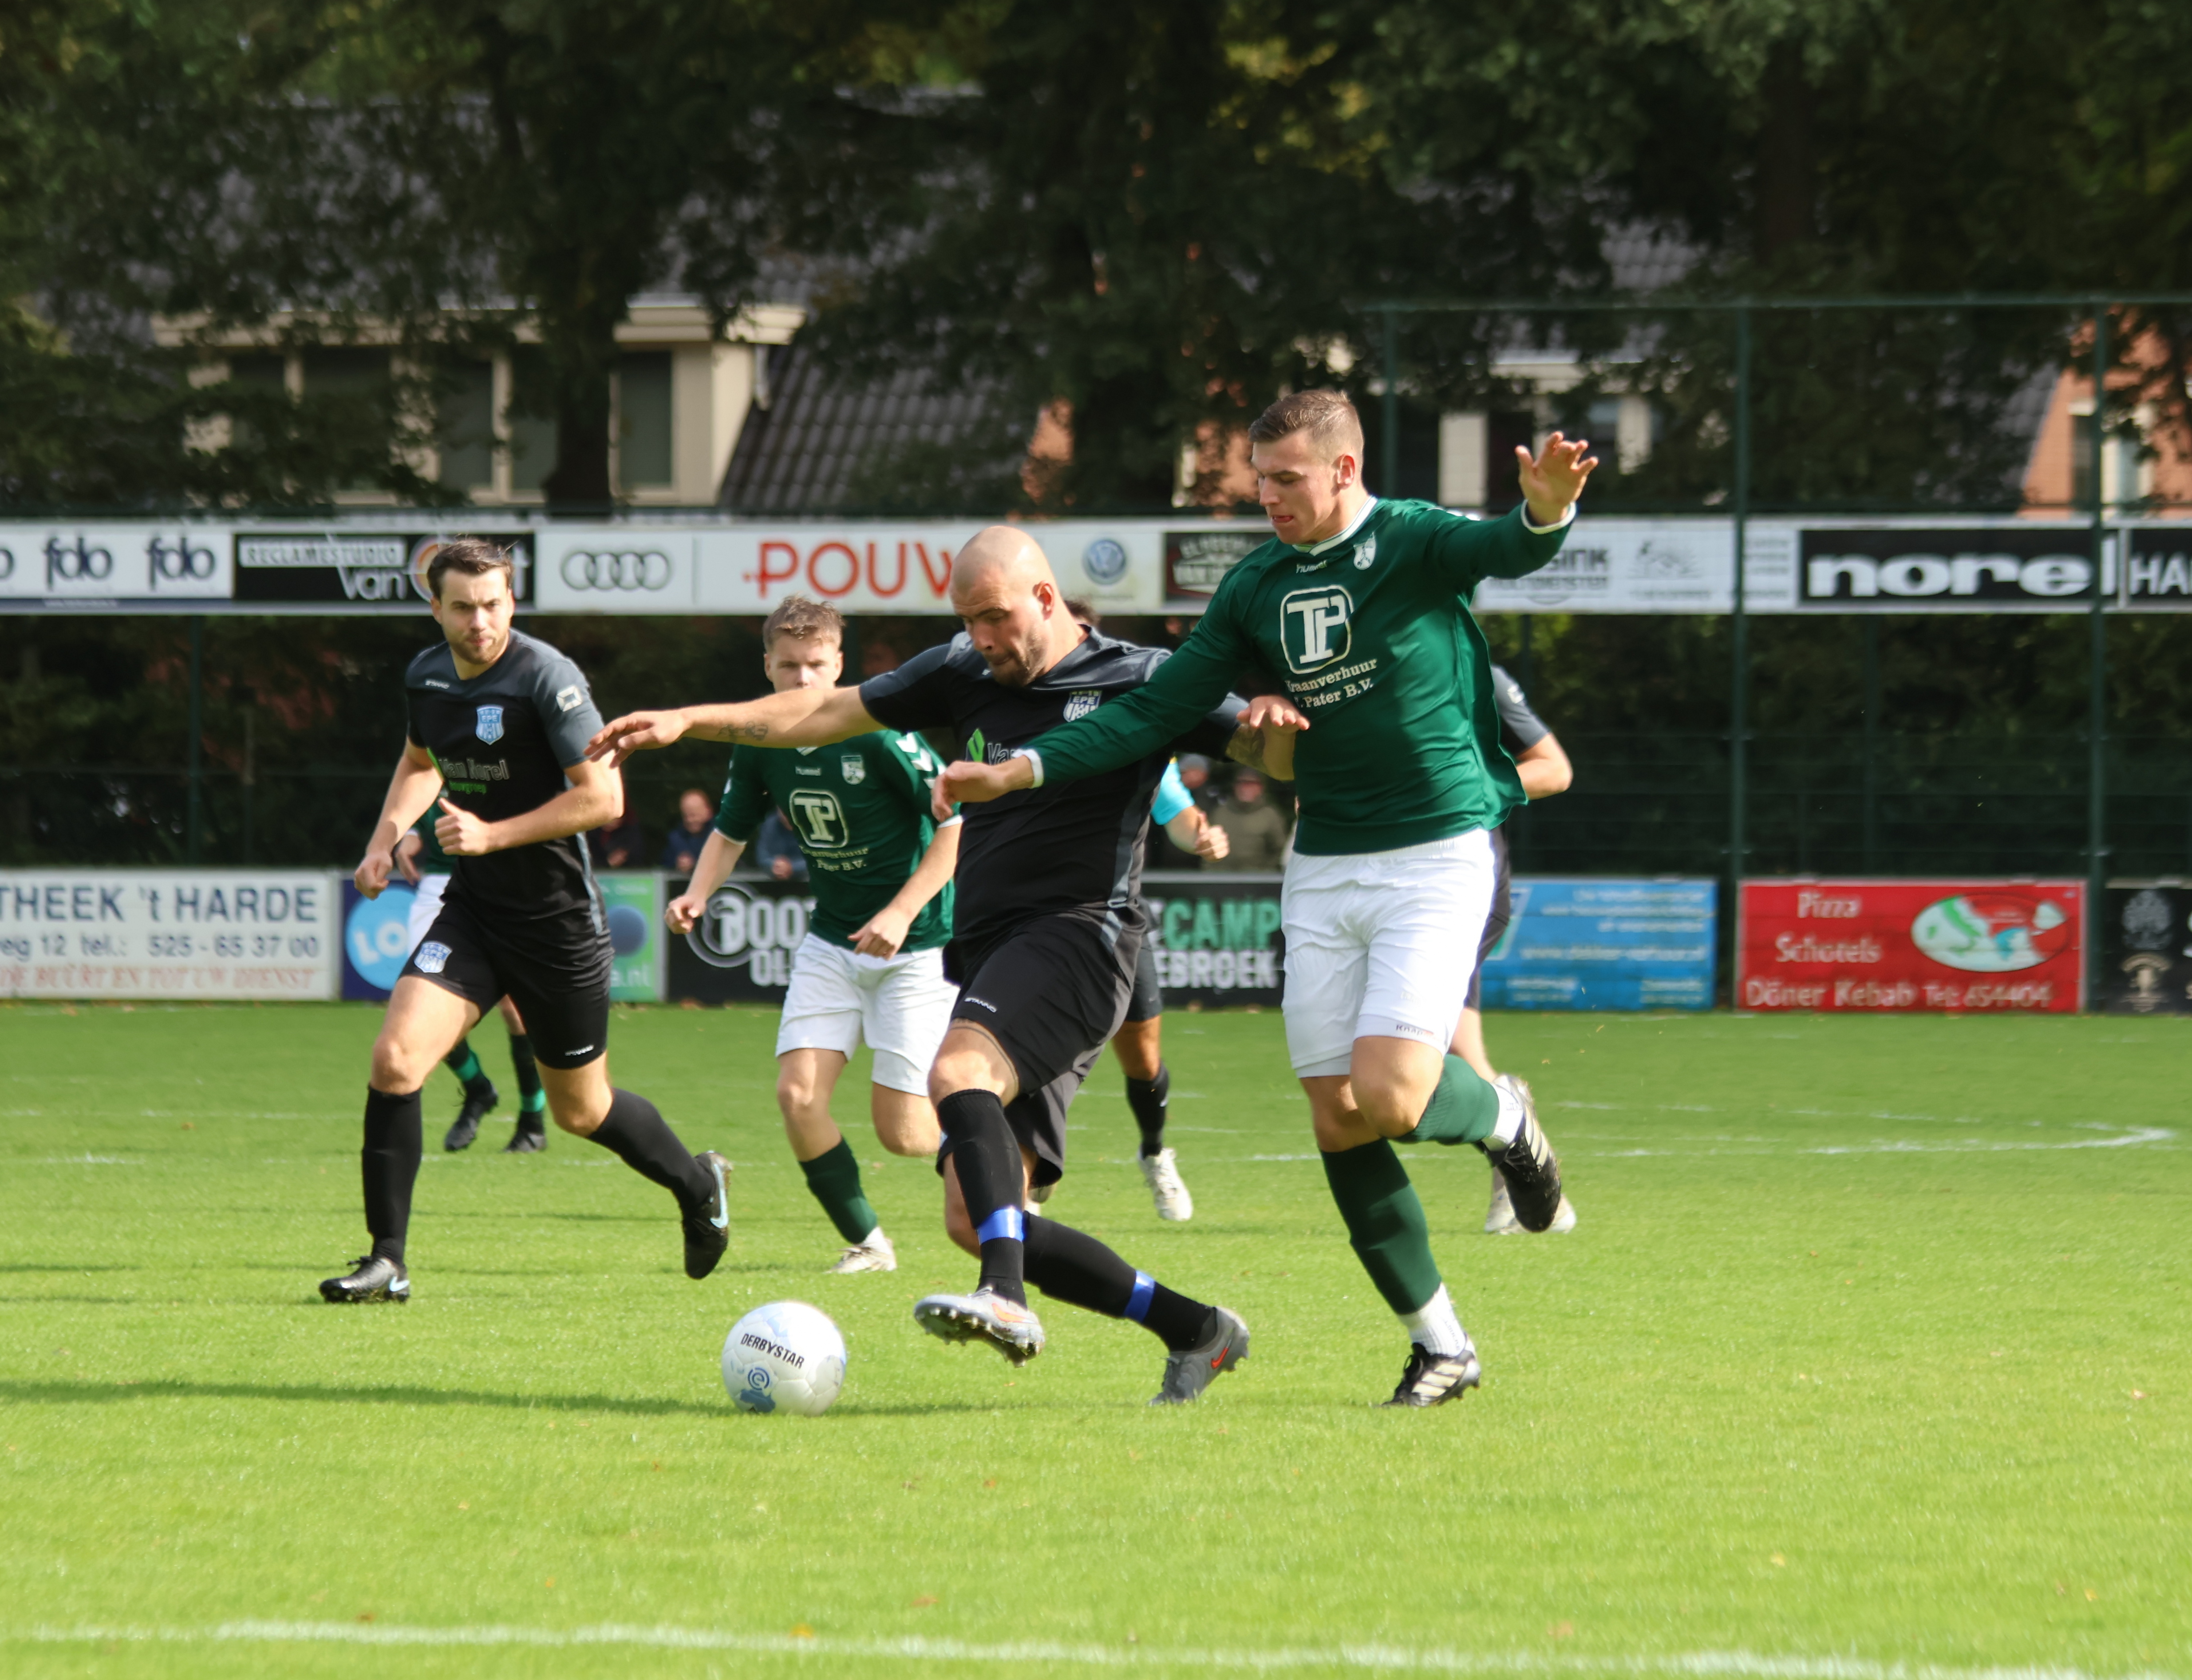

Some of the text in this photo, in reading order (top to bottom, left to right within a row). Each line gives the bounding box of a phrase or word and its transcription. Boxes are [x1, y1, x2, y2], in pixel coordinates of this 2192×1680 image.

[246, 546, 397, 562] RECLAMESTUDIO
[2129, 554, 2192, 595] HA
[1303, 690, 1342, 708] Pater
[987, 742, 1015, 766] Va
[177, 887, 318, 922] HARDE
[1150, 897, 1282, 950] CAMP
[148, 936, 192, 958] 525
[750, 949, 796, 988] OL
[740, 1333, 805, 1369] DERBYSTAR
